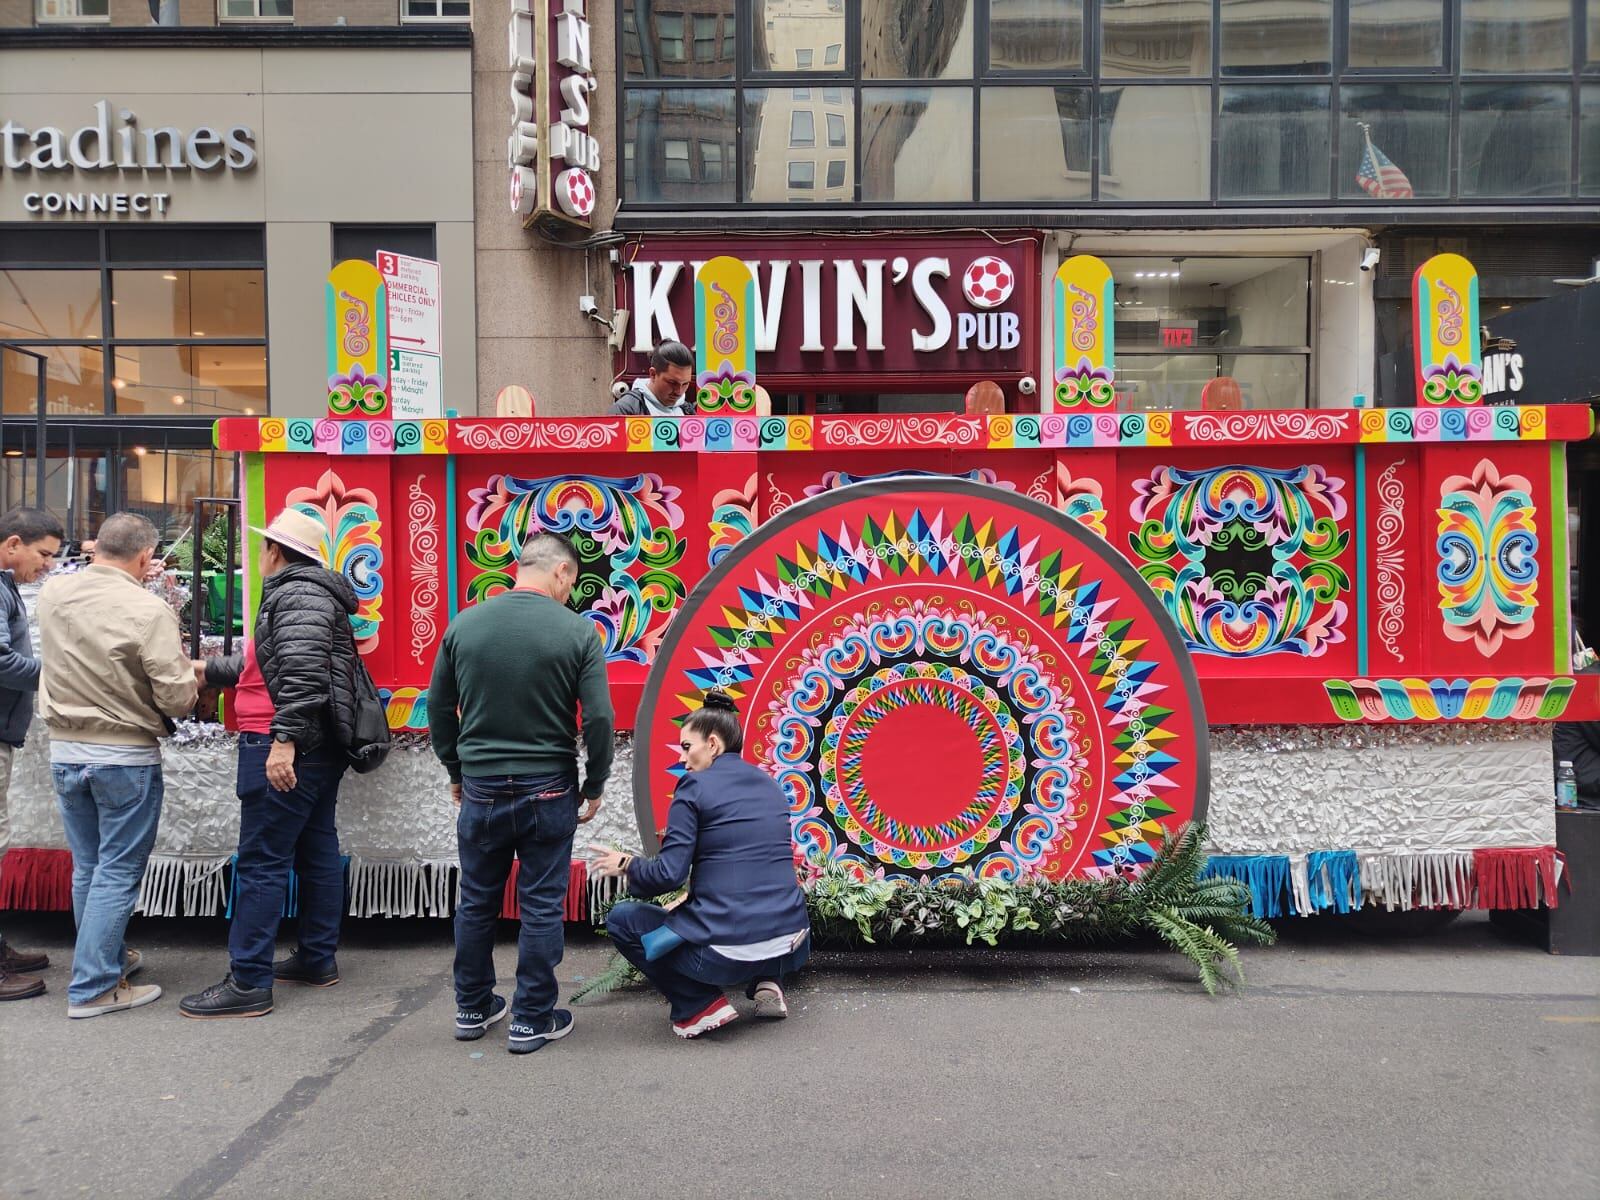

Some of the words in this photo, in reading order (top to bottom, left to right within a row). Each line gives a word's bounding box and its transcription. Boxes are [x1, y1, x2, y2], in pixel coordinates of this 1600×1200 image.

[552, 122, 600, 172] PUB
[23, 192, 170, 213] CONNECT
[383, 255, 394, 274] 3
[386, 280, 428, 296] OMMERCIAL
[388, 290, 416, 304] EHICLES
[418, 296, 436, 307] ONLY
[630, 257, 952, 353] KVIN'S
[956, 311, 1020, 351] PUB
[1482, 353, 1524, 395] AN'S
